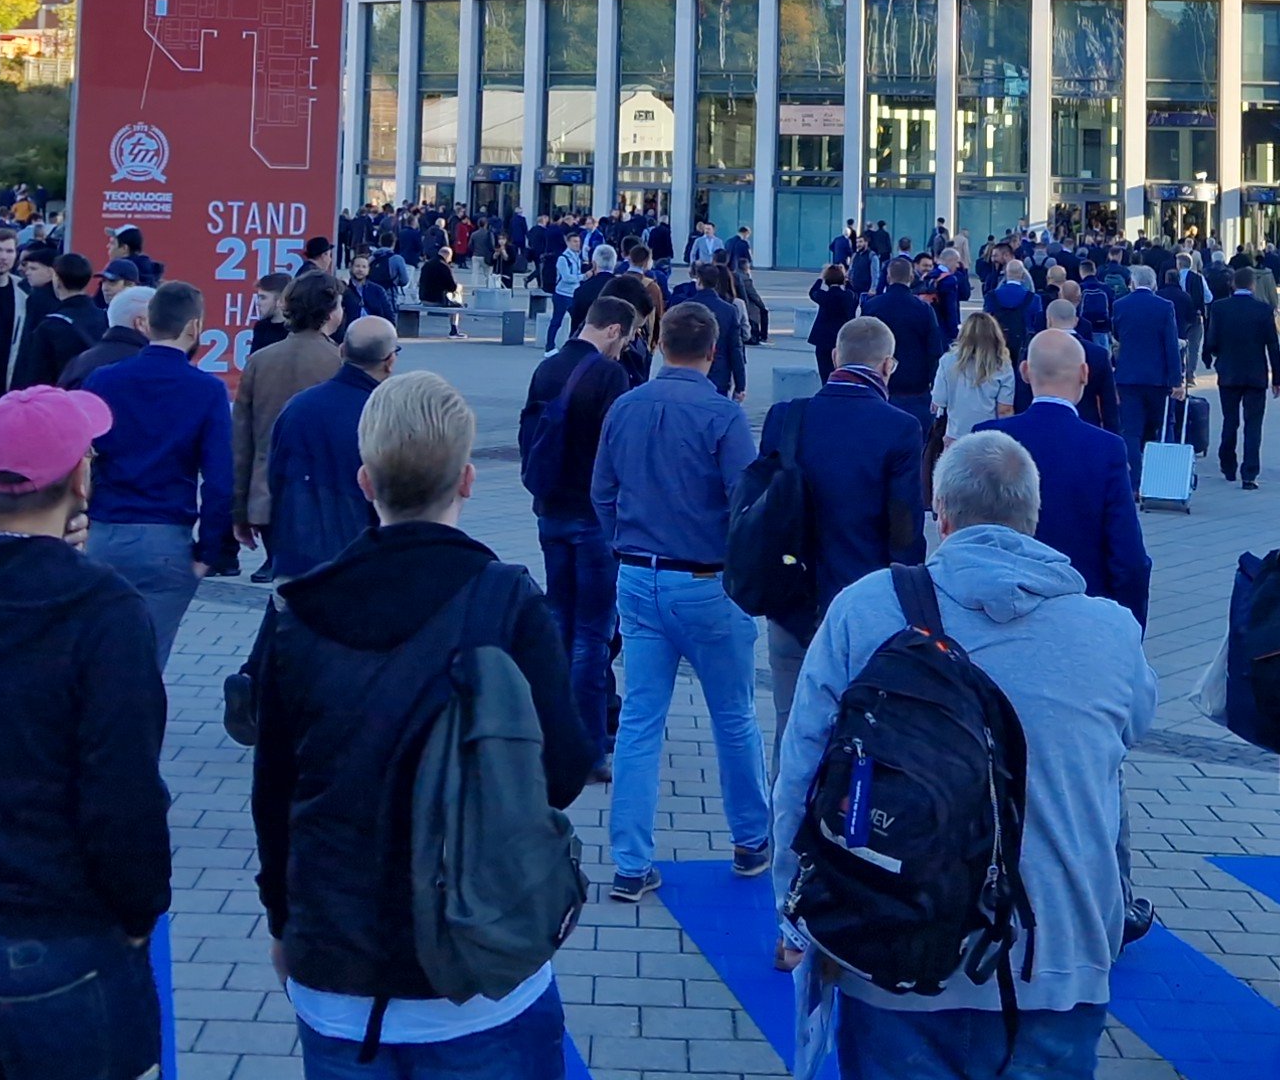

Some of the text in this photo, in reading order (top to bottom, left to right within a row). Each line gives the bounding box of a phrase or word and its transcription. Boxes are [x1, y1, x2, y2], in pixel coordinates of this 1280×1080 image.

[103, 191, 173, 202] TECNOLOGIE
[103, 202, 172, 212] MECCANICHE
[207, 201, 306, 236] STAND
[215, 238, 305, 280] 215
